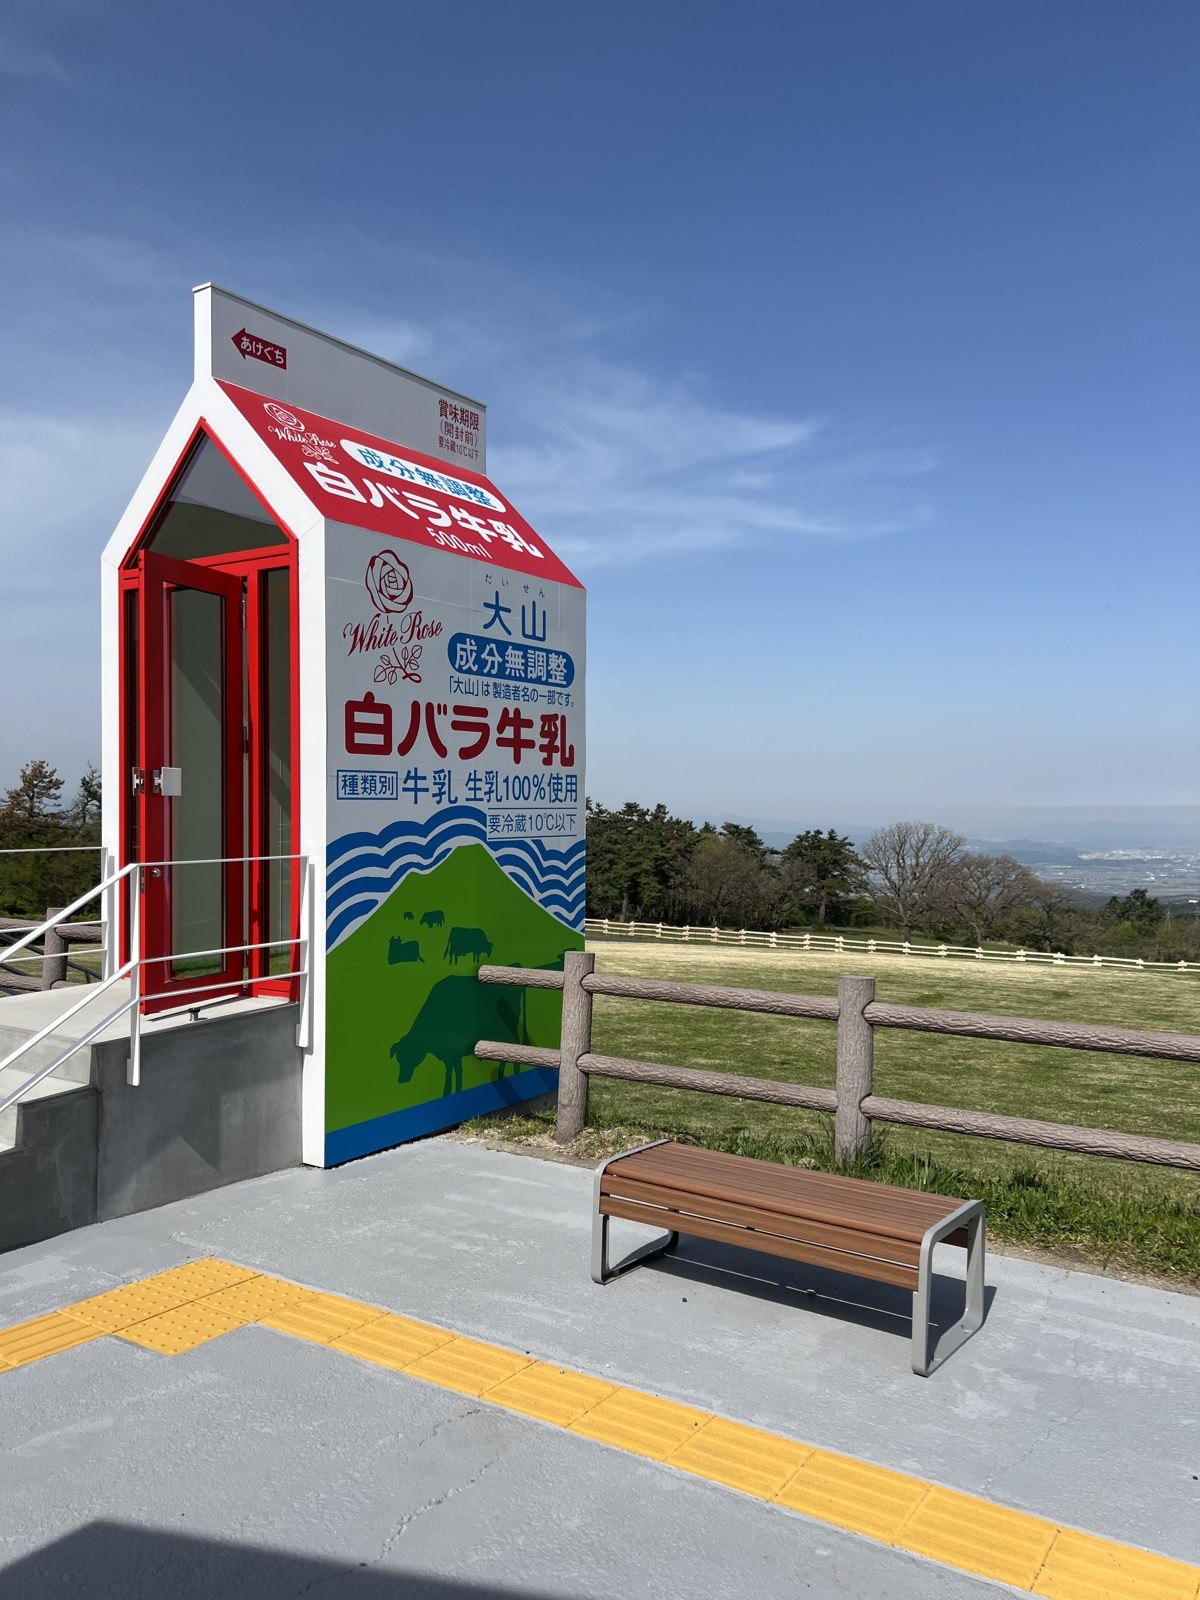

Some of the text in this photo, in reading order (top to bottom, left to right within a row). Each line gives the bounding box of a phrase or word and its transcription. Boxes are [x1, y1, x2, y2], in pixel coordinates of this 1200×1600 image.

[240, 335, 285, 365] あけぐち
[438, 398, 480, 432] 賞味期限
[267, 425, 337, 449] White Rose
[357, 447, 498, 509] 成分無調整
[303, 461, 545, 559] 白バラ牛乳
[426, 526, 493, 559] 500ml
[342, 610, 443, 657] White Rose
[482, 590, 547, 642] 大山
[454, 638, 568, 686] 成分無調整
[449, 675, 575, 708] 「大山」は製造者名の一部です。
[344, 691, 575, 767] 白バラ牛乳
[341, 773, 395, 797] 種類別
[401, 767, 459, 805] 牛乳
